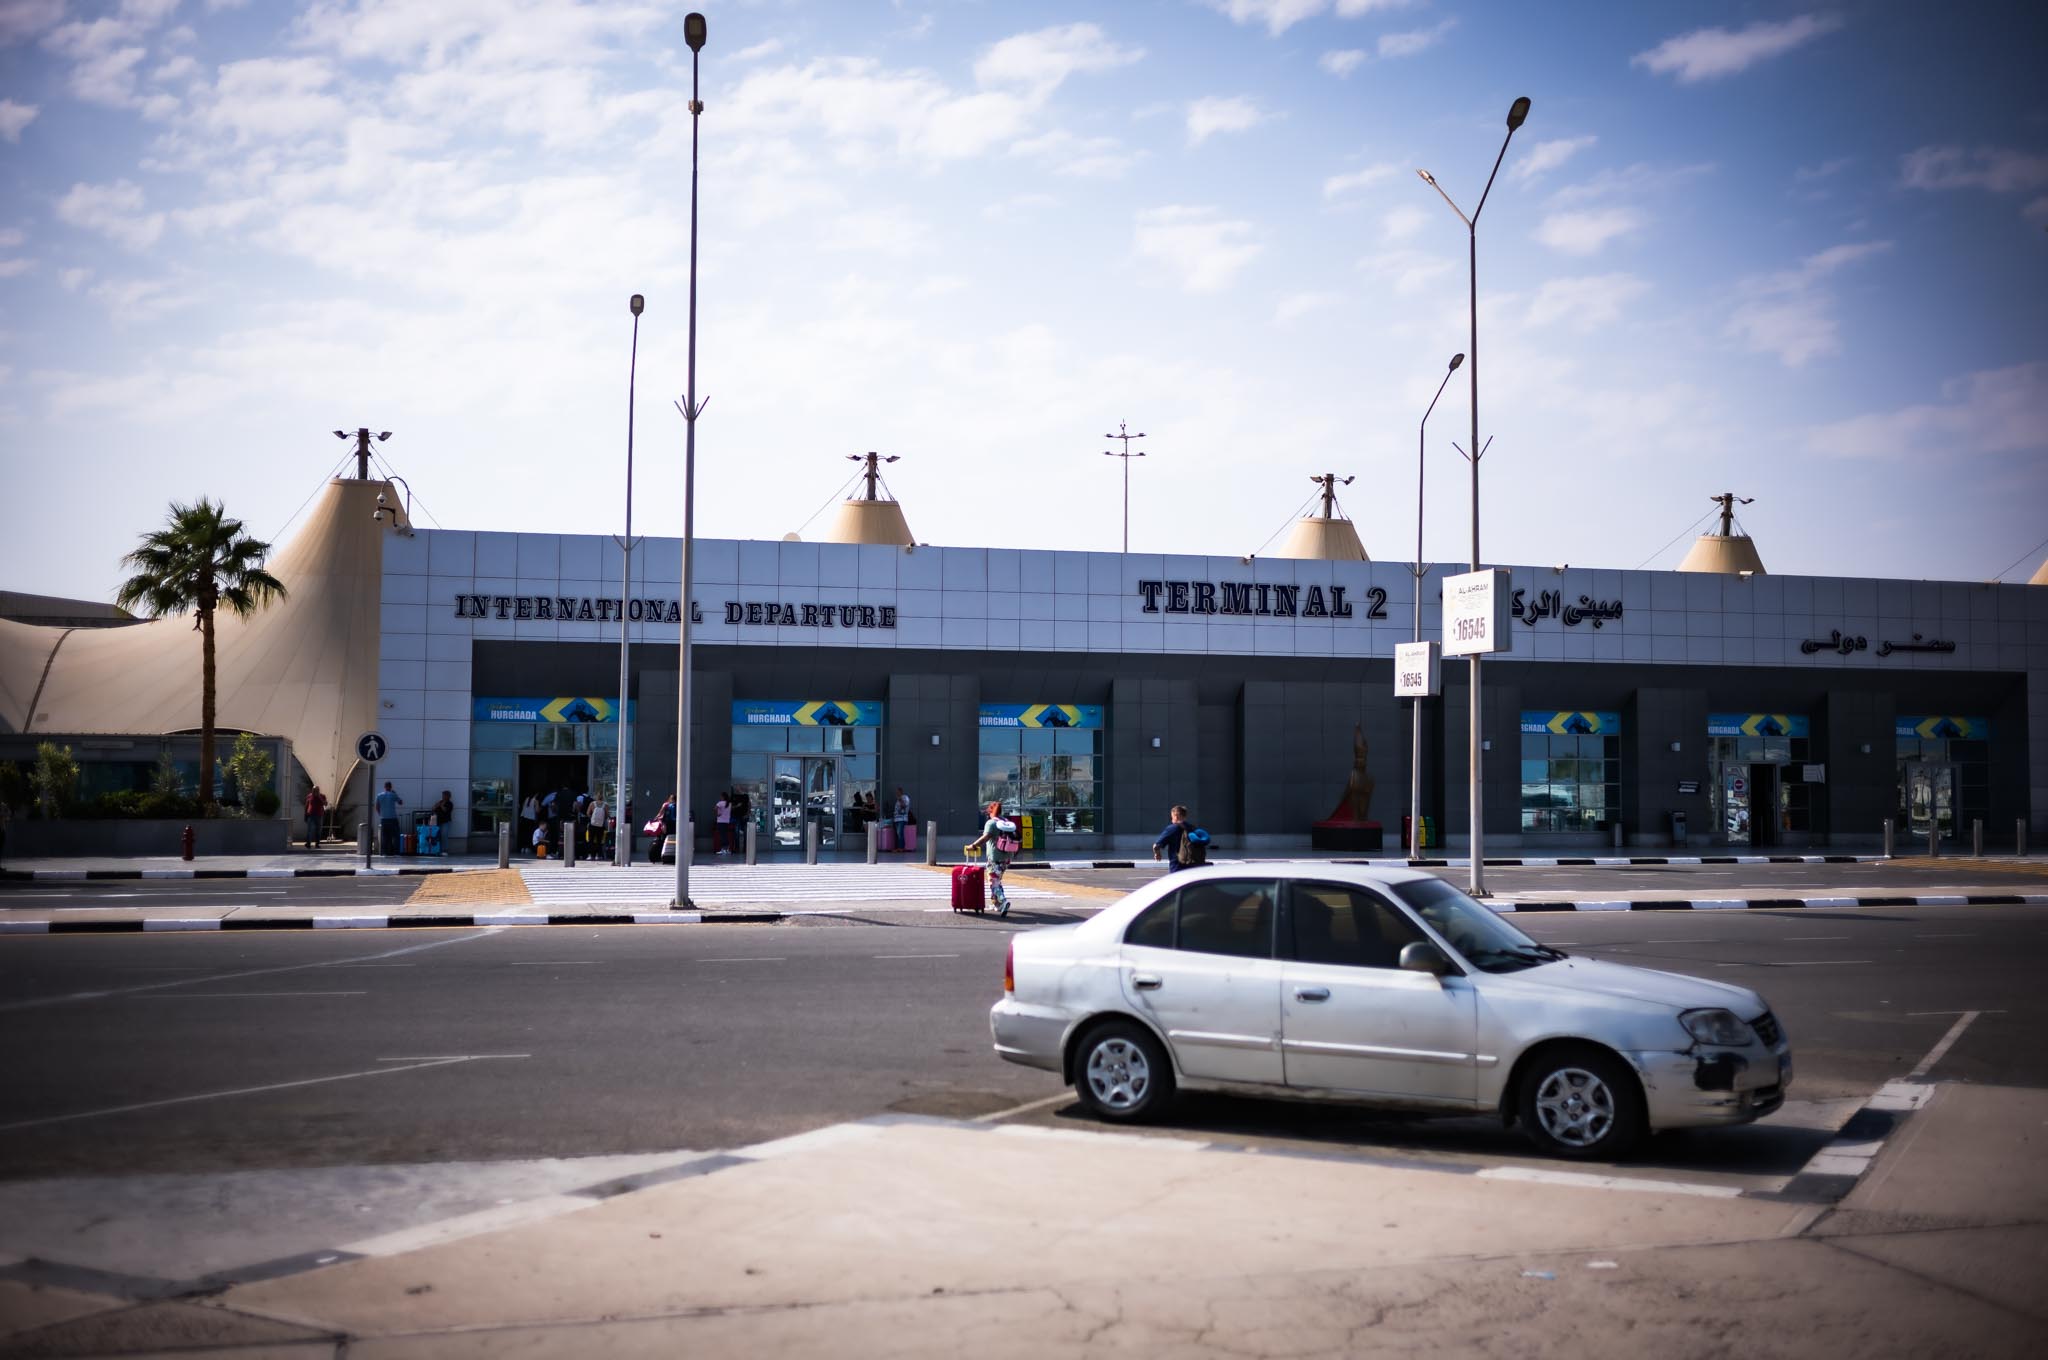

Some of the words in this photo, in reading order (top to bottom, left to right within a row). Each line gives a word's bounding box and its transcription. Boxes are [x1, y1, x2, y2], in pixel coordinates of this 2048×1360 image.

[1139, 580, 1353, 618] TERMINAL
[1367, 587, 1388, 619] 2
[454, 594, 703, 624] INTERNATIONAL
[725, 600, 898, 629] DEPARTURE
[1458, 617, 1486, 641] 16545
[1403, 672, 1422, 687] 16545
[490, 710, 537, 720] HURGHADA
[747, 713, 791, 723] HURGHADA
